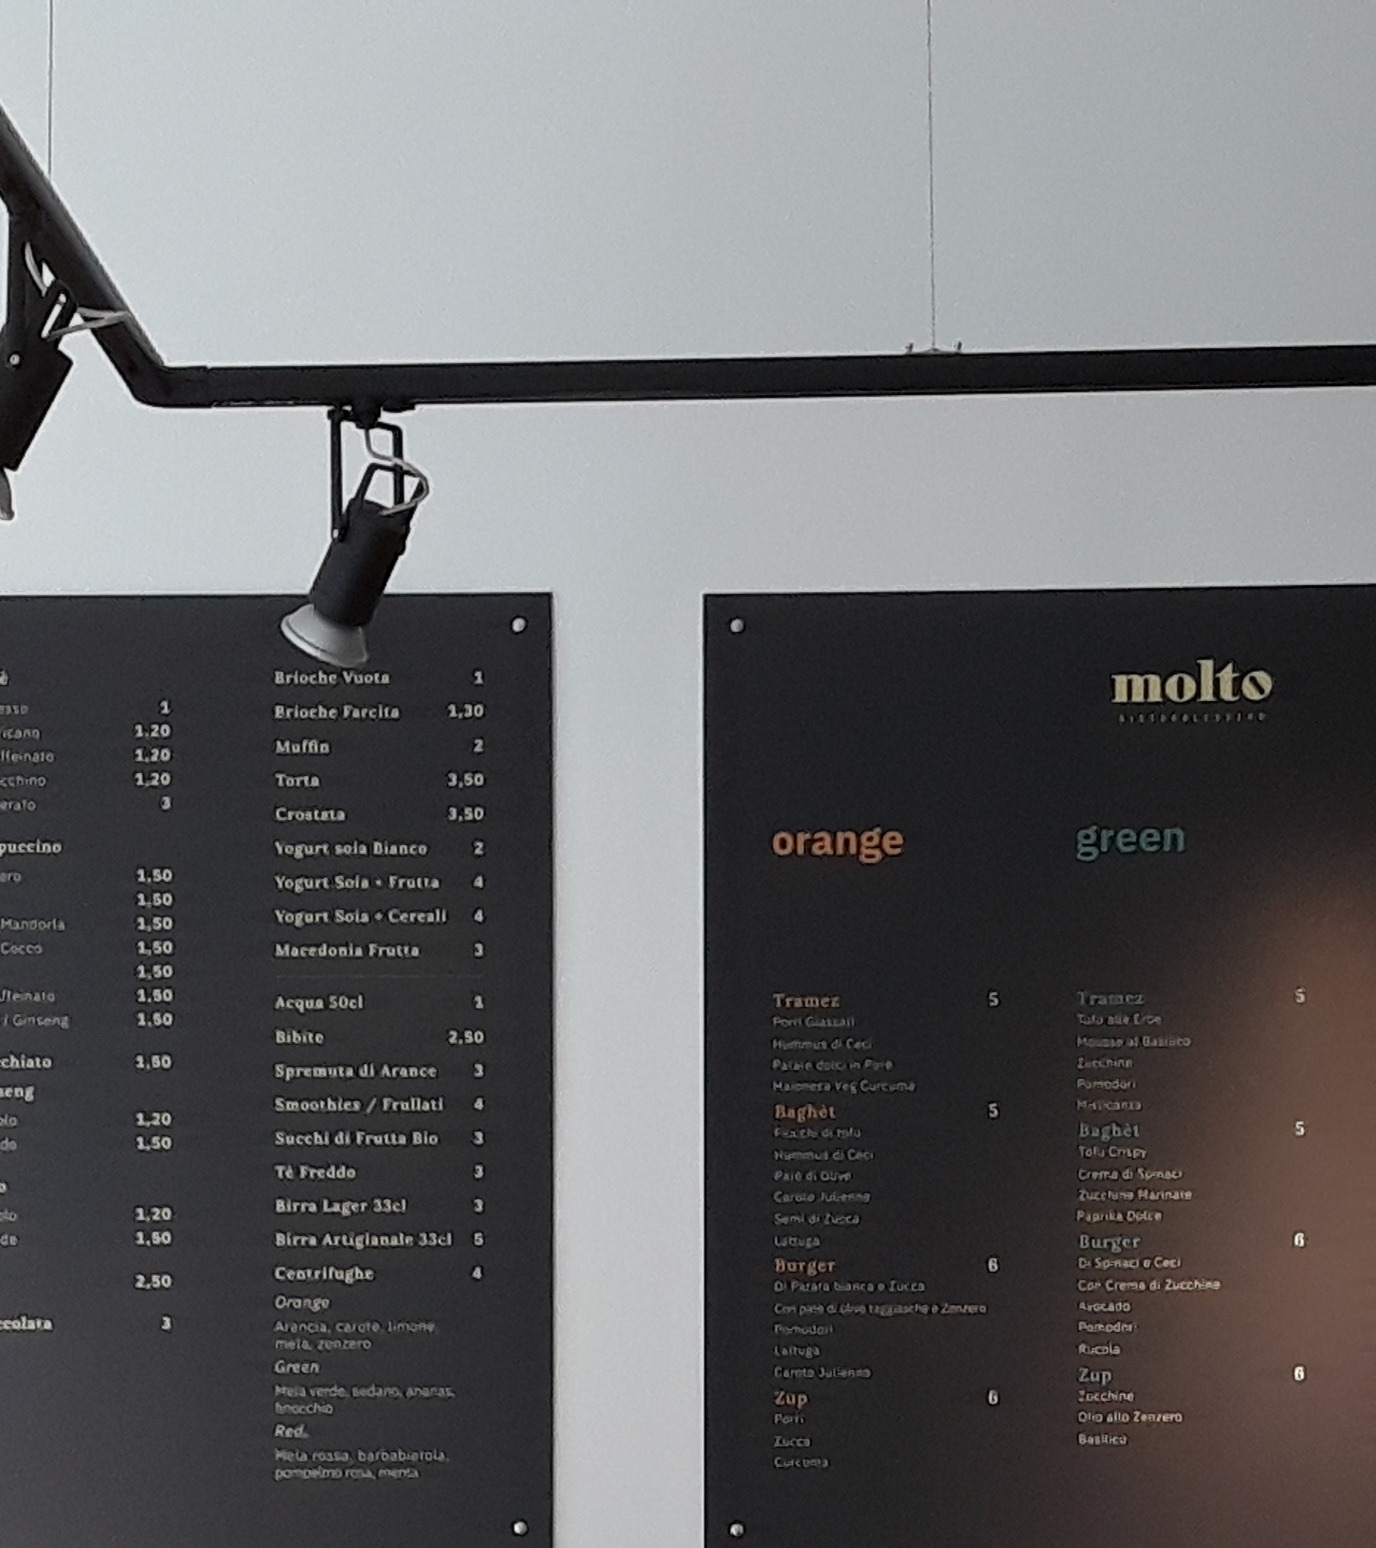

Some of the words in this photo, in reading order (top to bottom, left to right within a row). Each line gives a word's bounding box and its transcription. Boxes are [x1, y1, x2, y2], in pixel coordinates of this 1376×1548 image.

[274, 669, 337, 685] Brioche
[342, 670, 390, 685] Vuota
[474, 670, 484, 685] 1
[1112, 660, 1272, 702] molto
[160, 700, 170, 714] 1
[274, 705, 338, 719] Brioche
[343, 704, 400, 719] Farcita
[275, 739, 330, 754] Muffin
[473, 738, 484, 753] 2
[275, 773, 320, 787] Torta
[161, 796, 171, 810] 3
[275, 807, 346, 822] Crostata
[274, 841, 329, 860] Yogurt
[474, 841, 484, 855] 2
[773, 828, 903, 863] orange
[1077, 826, 1184, 861] green
[274, 875, 330, 894] Yogurt
[473, 875, 484, 888] 4
[274, 909, 329, 927] Yogurt
[474, 909, 484, 923] 4
[474, 942, 484, 957] 3
[275, 996, 324, 1013] Acqua
[474, 995, 484, 1009] 1
[772, 993, 840, 1008] Tramez
[988, 991, 999, 1007] 5
[1295, 988, 1306, 1004] 5
[275, 1029, 324, 1044] Bibite
[358, 1063, 375, 1078] di
[474, 1063, 484, 1078] 3
[473, 1097, 484, 1111] 4
[988, 1102, 999, 1118] 5
[1295, 1120, 1305, 1136] 5
[274, 1131, 330, 1146] Succhi
[334, 1131, 351, 1146] di
[412, 1130, 439, 1145] Bio
[473, 1131, 484, 1145] 3
[474, 1164, 484, 1179] 3
[275, 1199, 318, 1213] Birra
[474, 1198, 484, 1213] 3
[275, 1232, 317, 1247] Birra
[472, 1266, 482, 1280] 4
[161, 1316, 172, 1330] 3
[1078, 1367, 1112, 1386] Zup
[774, 1390, 808, 1410] Zup
